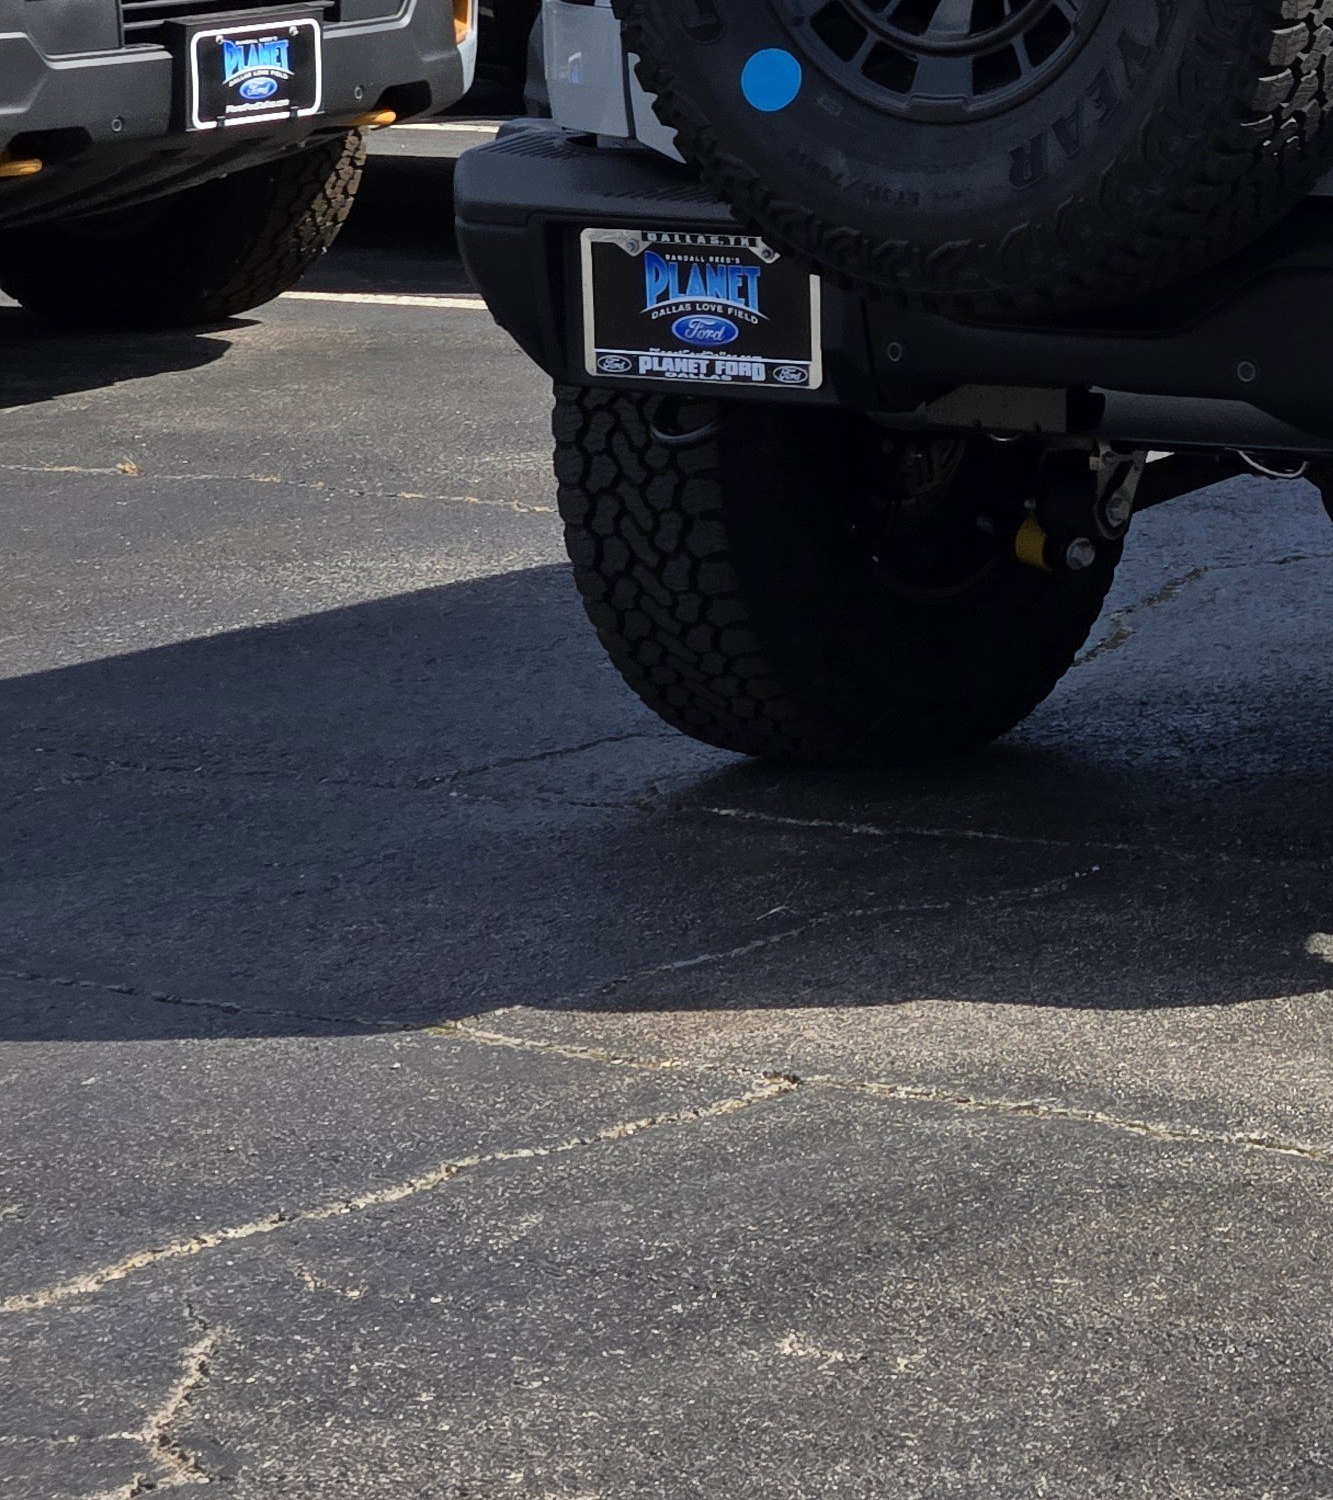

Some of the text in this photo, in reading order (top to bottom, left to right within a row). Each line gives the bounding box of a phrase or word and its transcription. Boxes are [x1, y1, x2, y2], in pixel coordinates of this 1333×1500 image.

[222, 39, 289, 81] PLANET
[644, 250, 760, 314] PLANET
[651, 303, 759, 325] DALLAS LOVE FIELD
[684, 317, 726, 343] Ford
[638, 355, 766, 382] PLANET FORD
[664, 371, 733, 381] DALLAS
